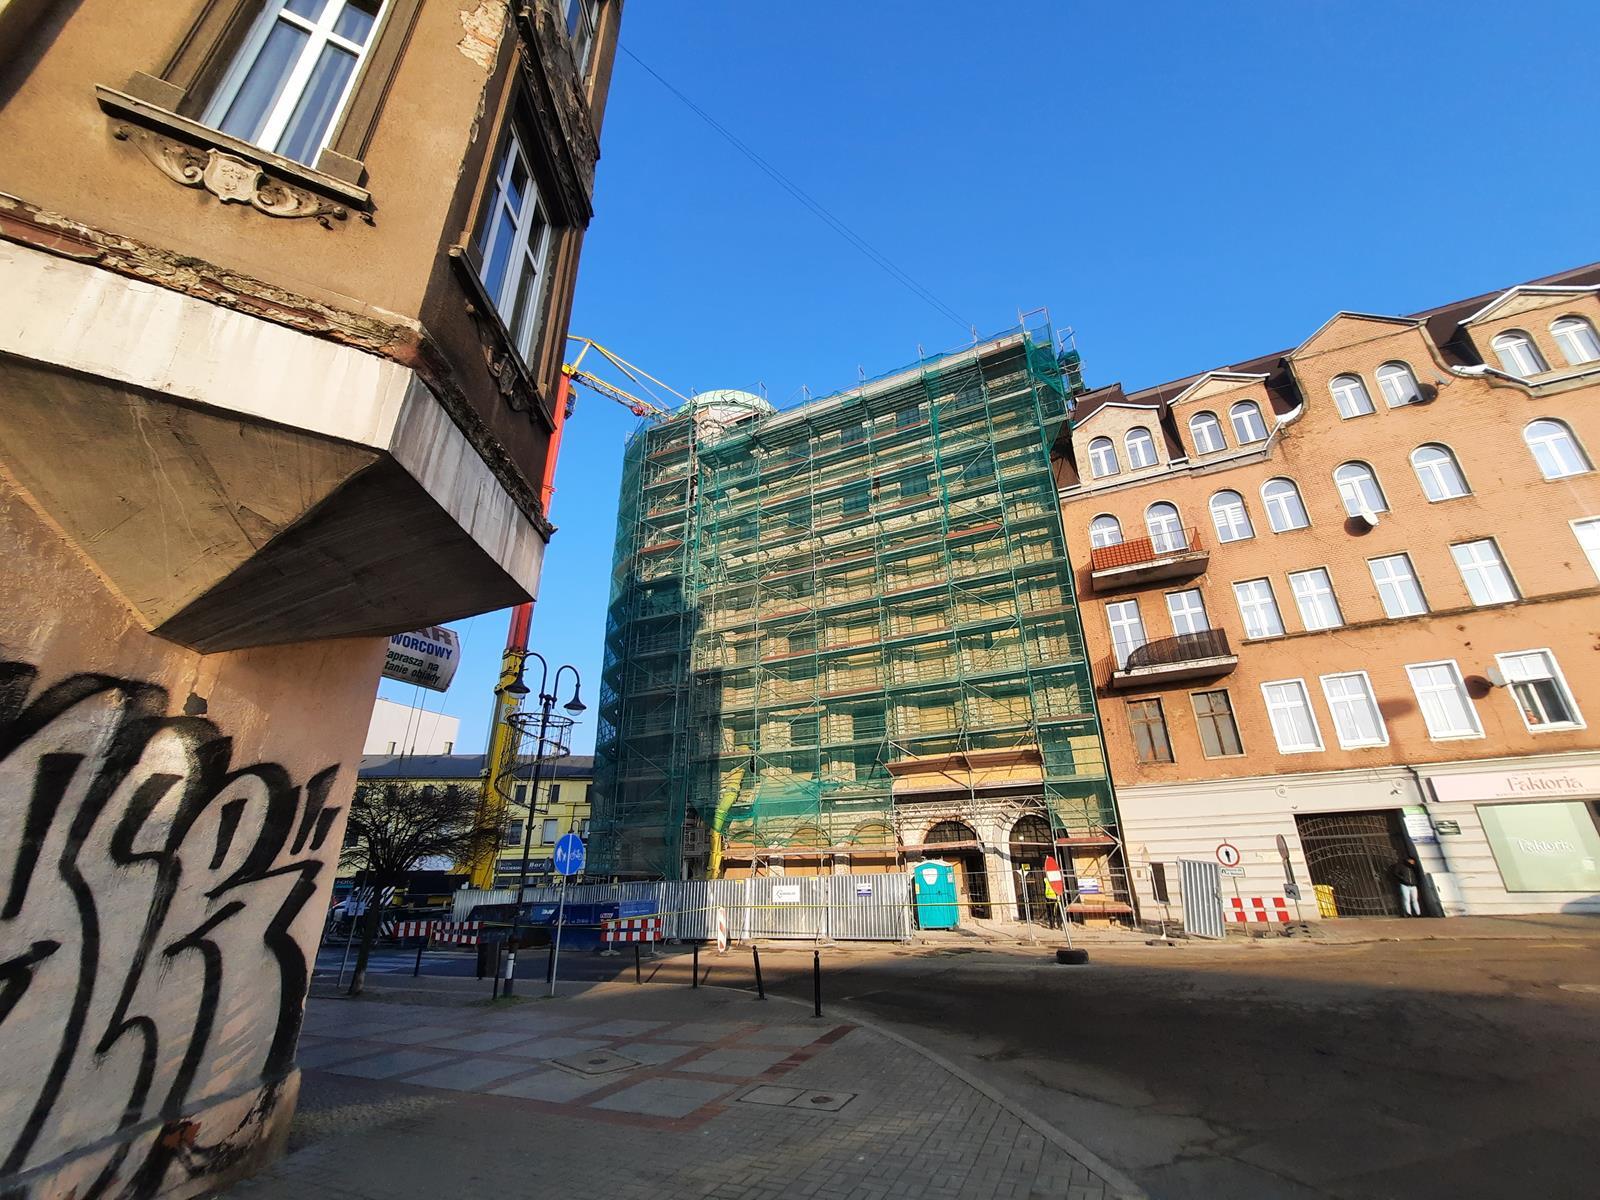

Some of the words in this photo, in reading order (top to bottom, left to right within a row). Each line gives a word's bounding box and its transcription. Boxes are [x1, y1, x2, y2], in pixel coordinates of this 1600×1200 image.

[391, 634, 453, 660] WORCOWY
[384, 661, 409, 675] tanie
[411, 669, 441, 686] obiady
[428, 662, 440, 672] na
[1506, 776, 1584, 792] Faktoria
